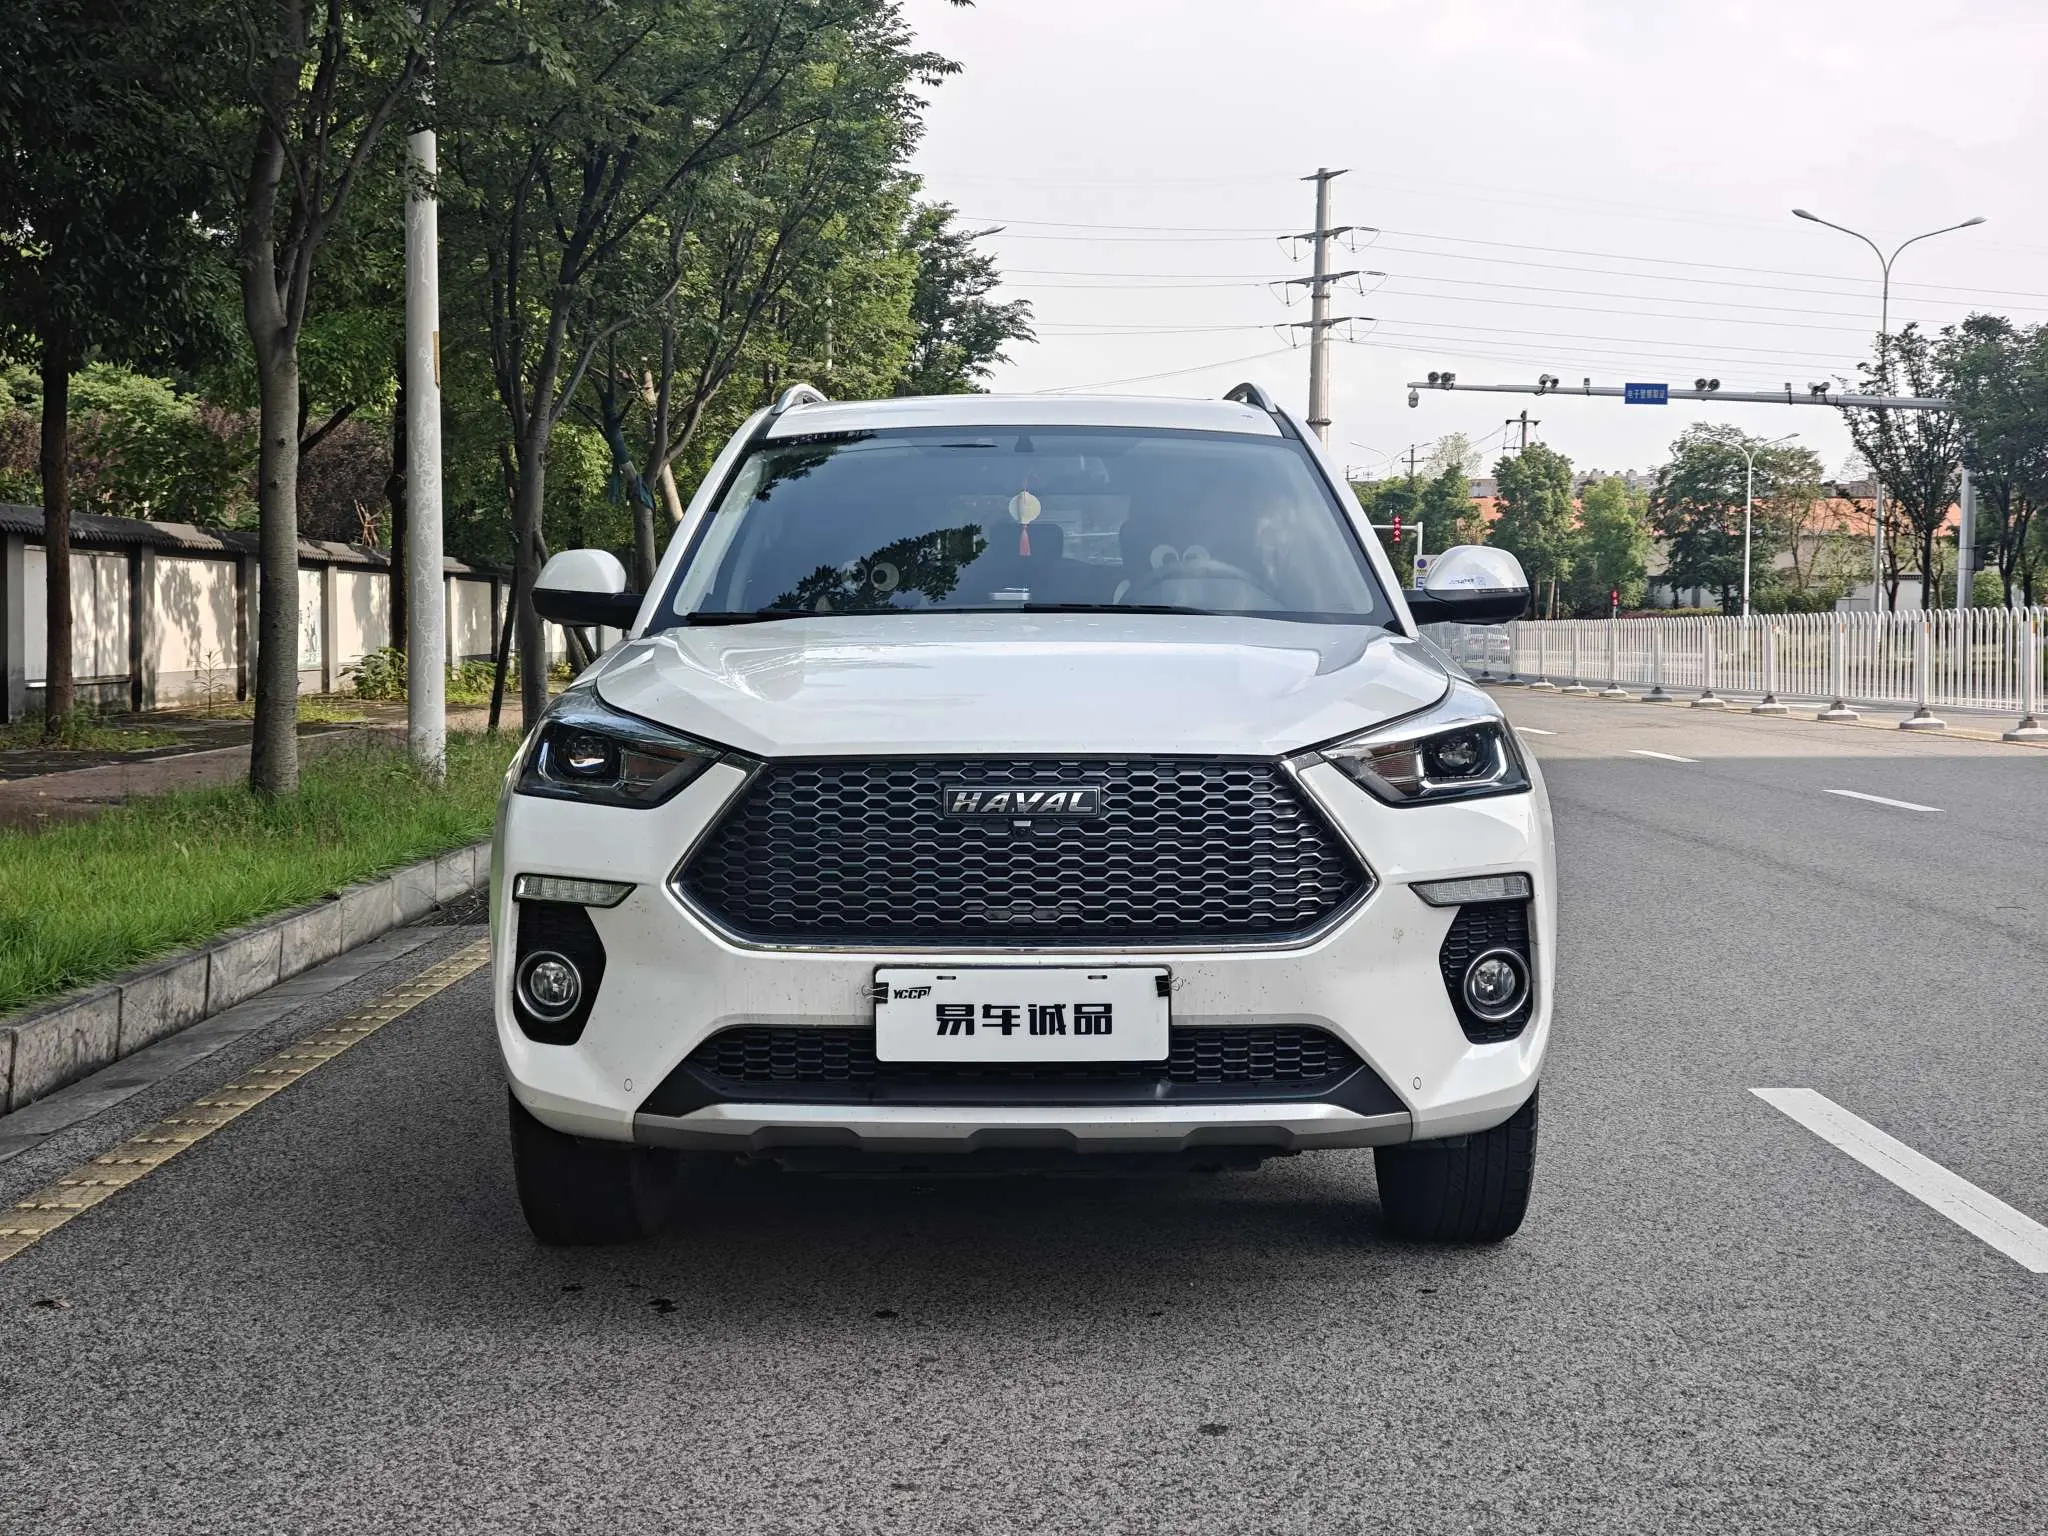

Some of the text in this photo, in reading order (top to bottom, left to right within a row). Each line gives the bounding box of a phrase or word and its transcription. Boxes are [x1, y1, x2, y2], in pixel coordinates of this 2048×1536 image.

[951, 792, 1093, 812] HAVAL
[893, 986, 931, 999] YCCP
[936, 1003, 1112, 1035] 易车诚品
